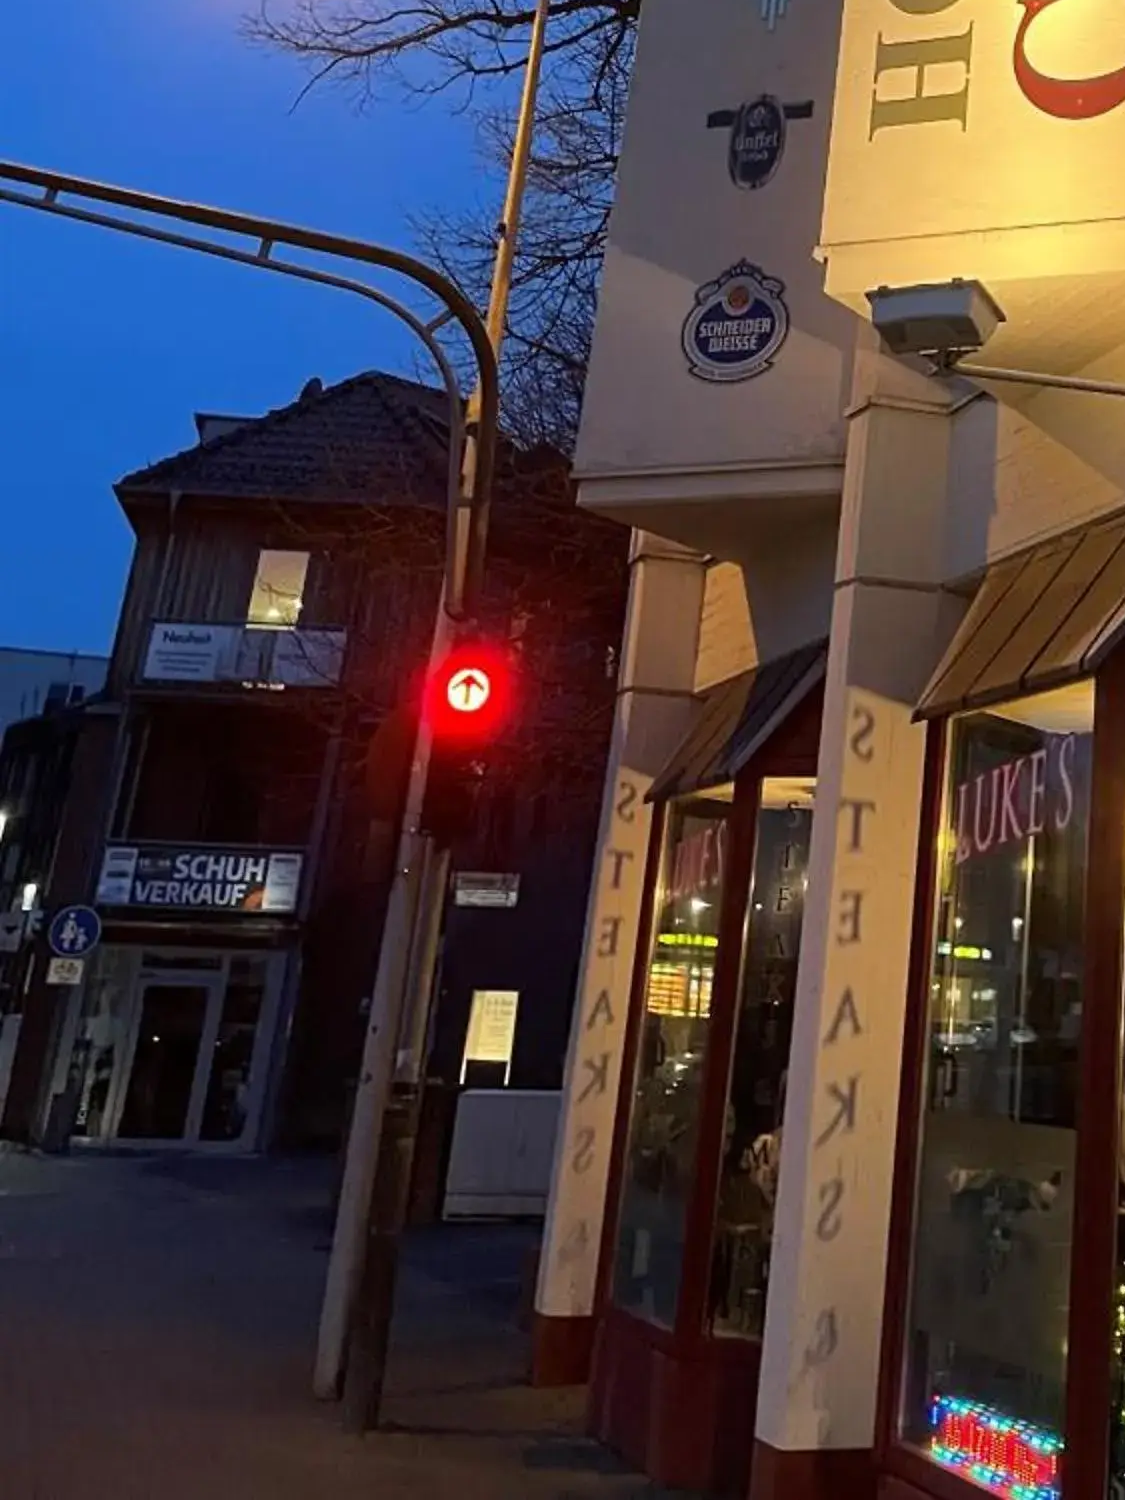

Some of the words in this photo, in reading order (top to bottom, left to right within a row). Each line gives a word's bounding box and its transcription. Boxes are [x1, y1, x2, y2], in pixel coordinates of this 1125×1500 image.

[699, 316, 772, 338] SCHNEIDER
[955, 735, 1076, 865] LUKE'S
[173, 854, 266, 883] SCHUH
[134, 880, 247, 906] VERKAUF
